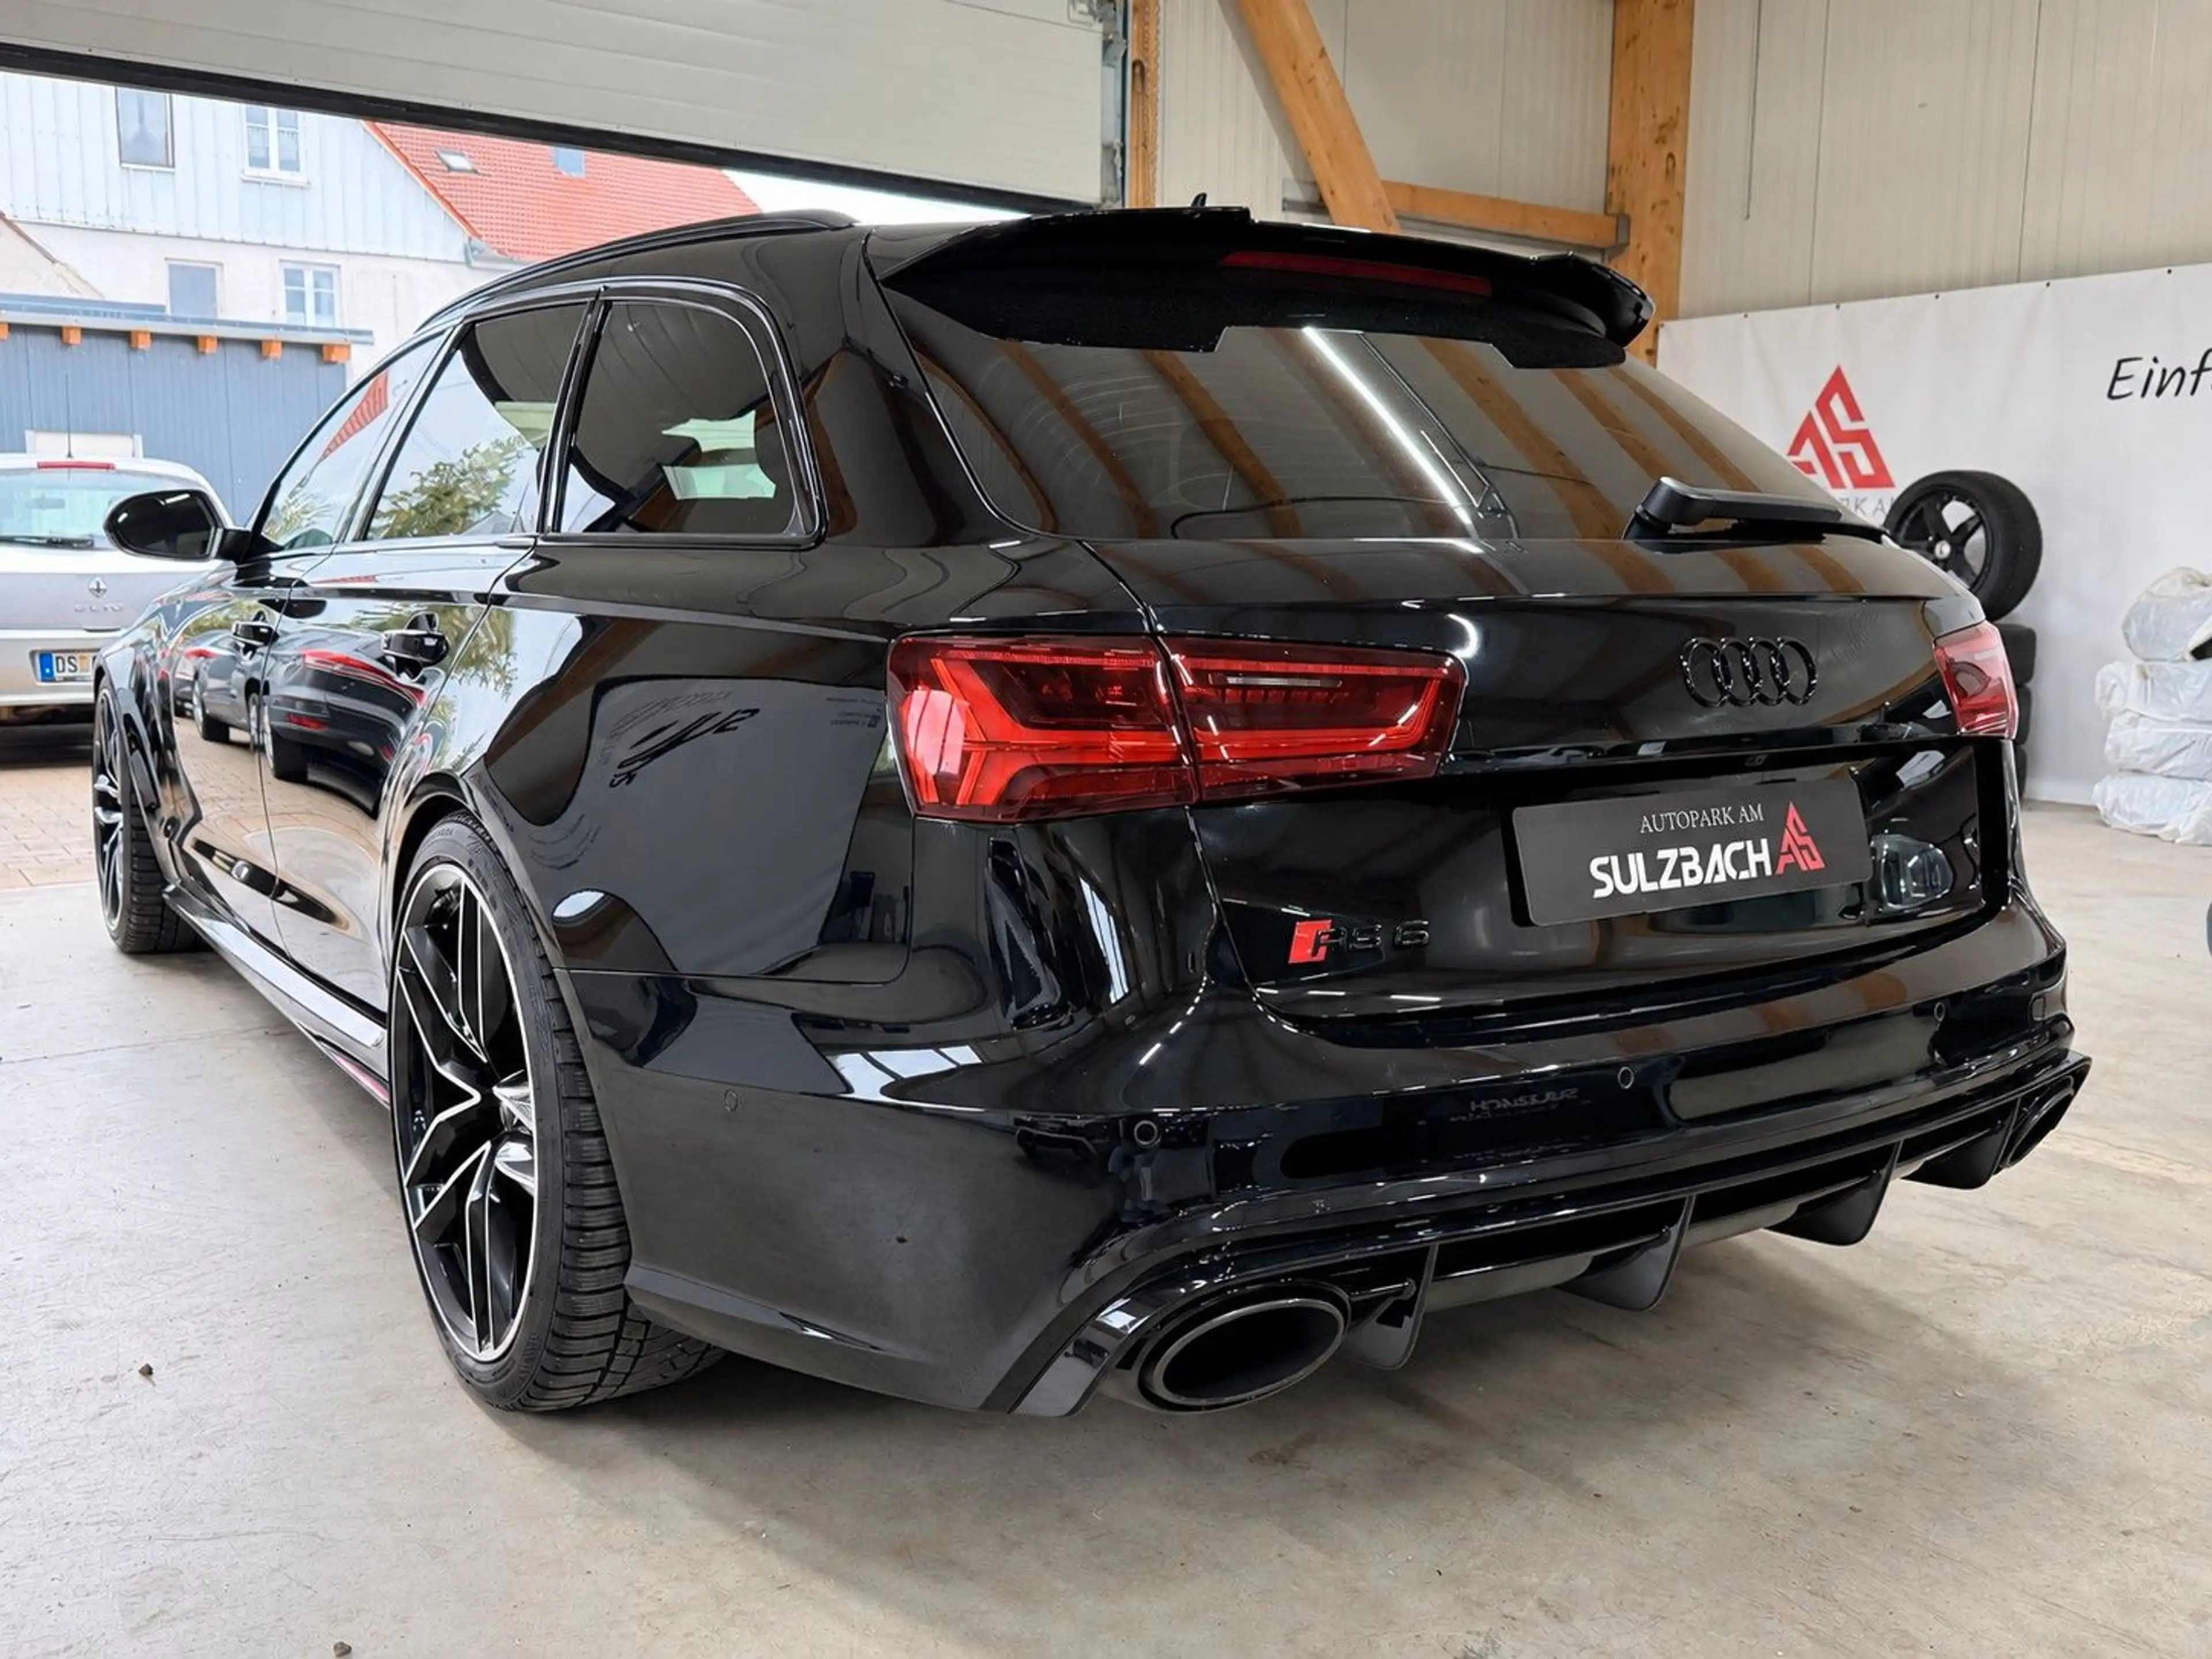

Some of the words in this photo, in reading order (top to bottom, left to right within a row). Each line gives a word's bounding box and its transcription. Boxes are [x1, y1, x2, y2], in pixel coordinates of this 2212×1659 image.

[2107, 347, 2212, 400] Einf
[56, 656, 78, 673] DS
[1640, 807, 1734, 834] AUTOPARK
[1738, 803, 1765, 825] AM
[1589, 838, 1772, 899] SULZBACH
